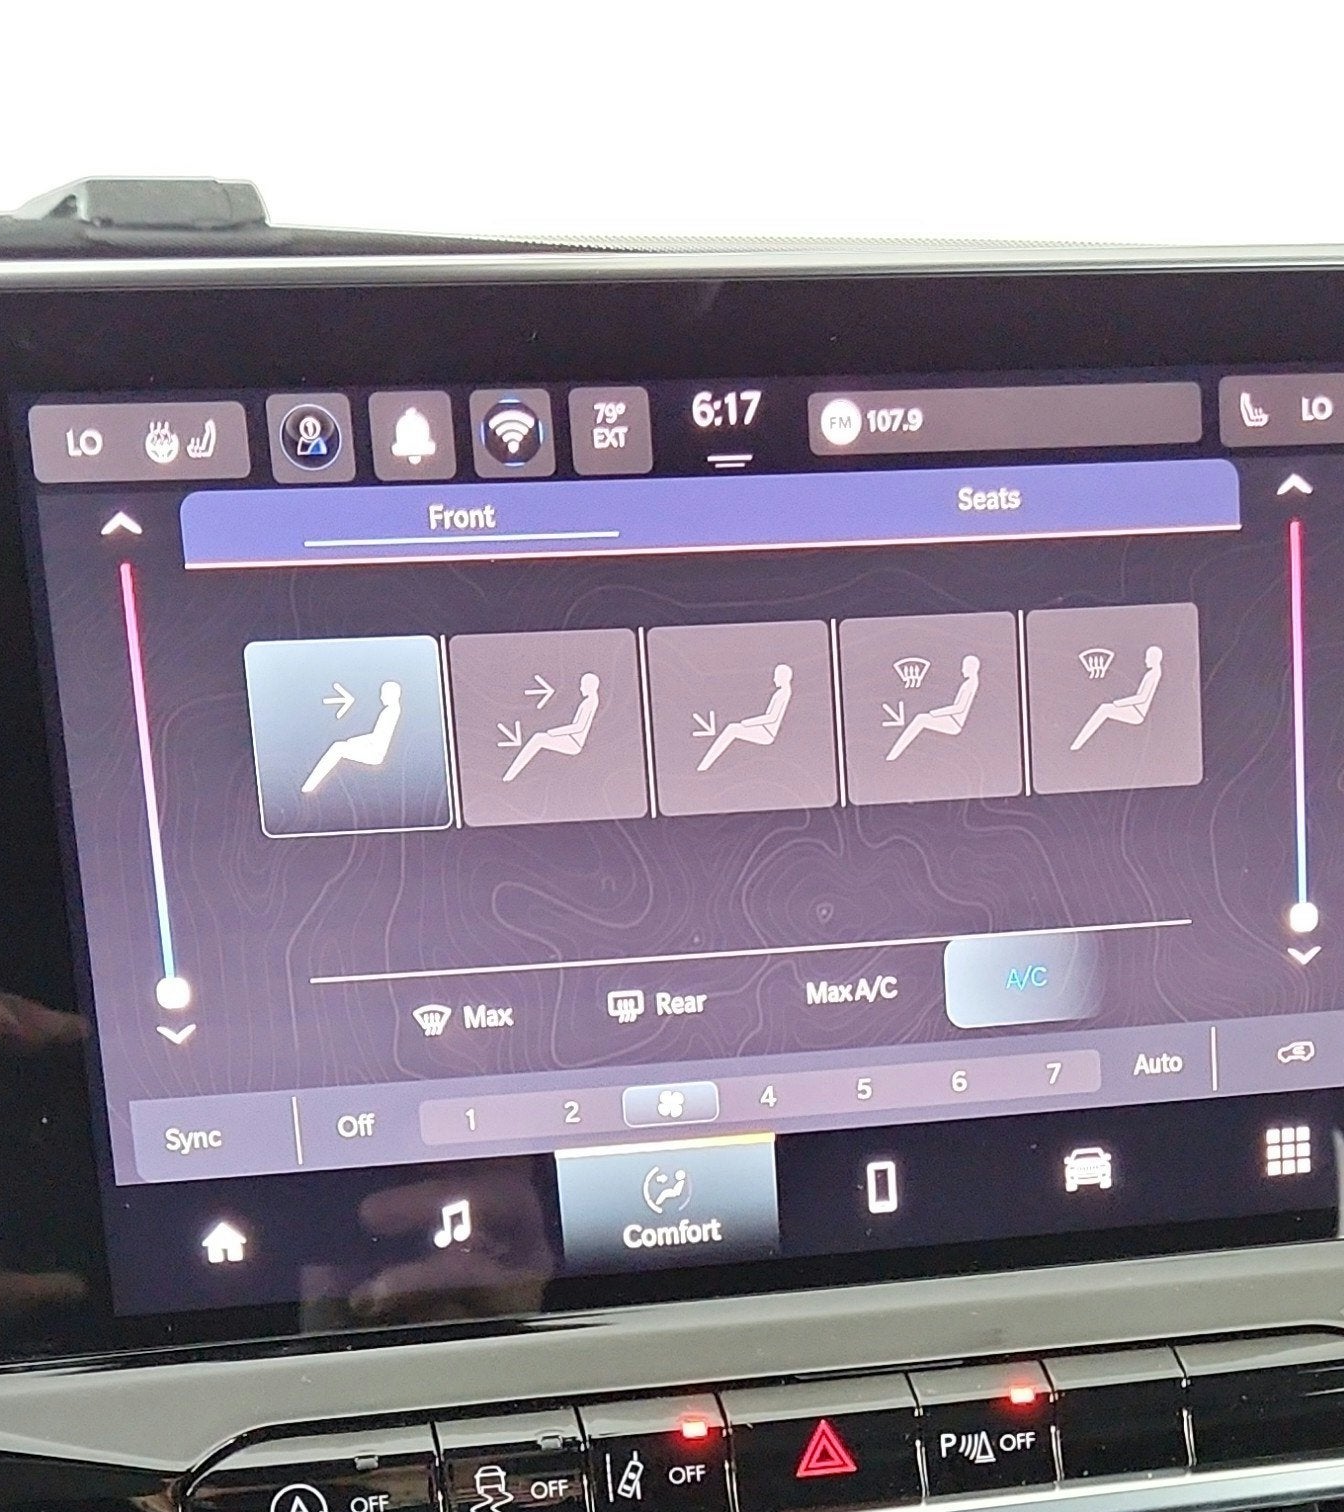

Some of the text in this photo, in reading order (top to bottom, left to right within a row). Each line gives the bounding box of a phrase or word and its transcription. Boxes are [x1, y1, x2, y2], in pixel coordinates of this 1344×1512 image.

[691, 390, 762, 428] 6:17
[866, 408, 924, 432] 107.9
[1301, 396, 1334, 422] LO
[828, 416, 853, 430] FM
[66, 428, 103, 457] LO
[593, 426, 627, 449] EXT
[957, 486, 1021, 512] Seats
[428, 504, 496, 531] Front
[806, 975, 898, 1004] Max A/C
[1006, 965, 1048, 991] A/C
[656, 992, 707, 1016] Rear
[463, 1004, 514, 1030] Max
[1045, 1063, 1062, 1085] 7
[1133, 1053, 1183, 1075] Auto
[856, 1078, 872, 1100] 5
[951, 1071, 968, 1092] 6
[759, 1086, 778, 1108] 4
[465, 1109, 476, 1131] 1
[564, 1101, 581, 1123] 2
[337, 1112, 375, 1138] Off
[165, 1127, 222, 1155] Sync
[622, 1219, 722, 1249] Comfort
[999, 1431, 1036, 1453] OFF
[668, 1464, 707, 1486] OFF
[530, 1479, 569, 1500] OFF
